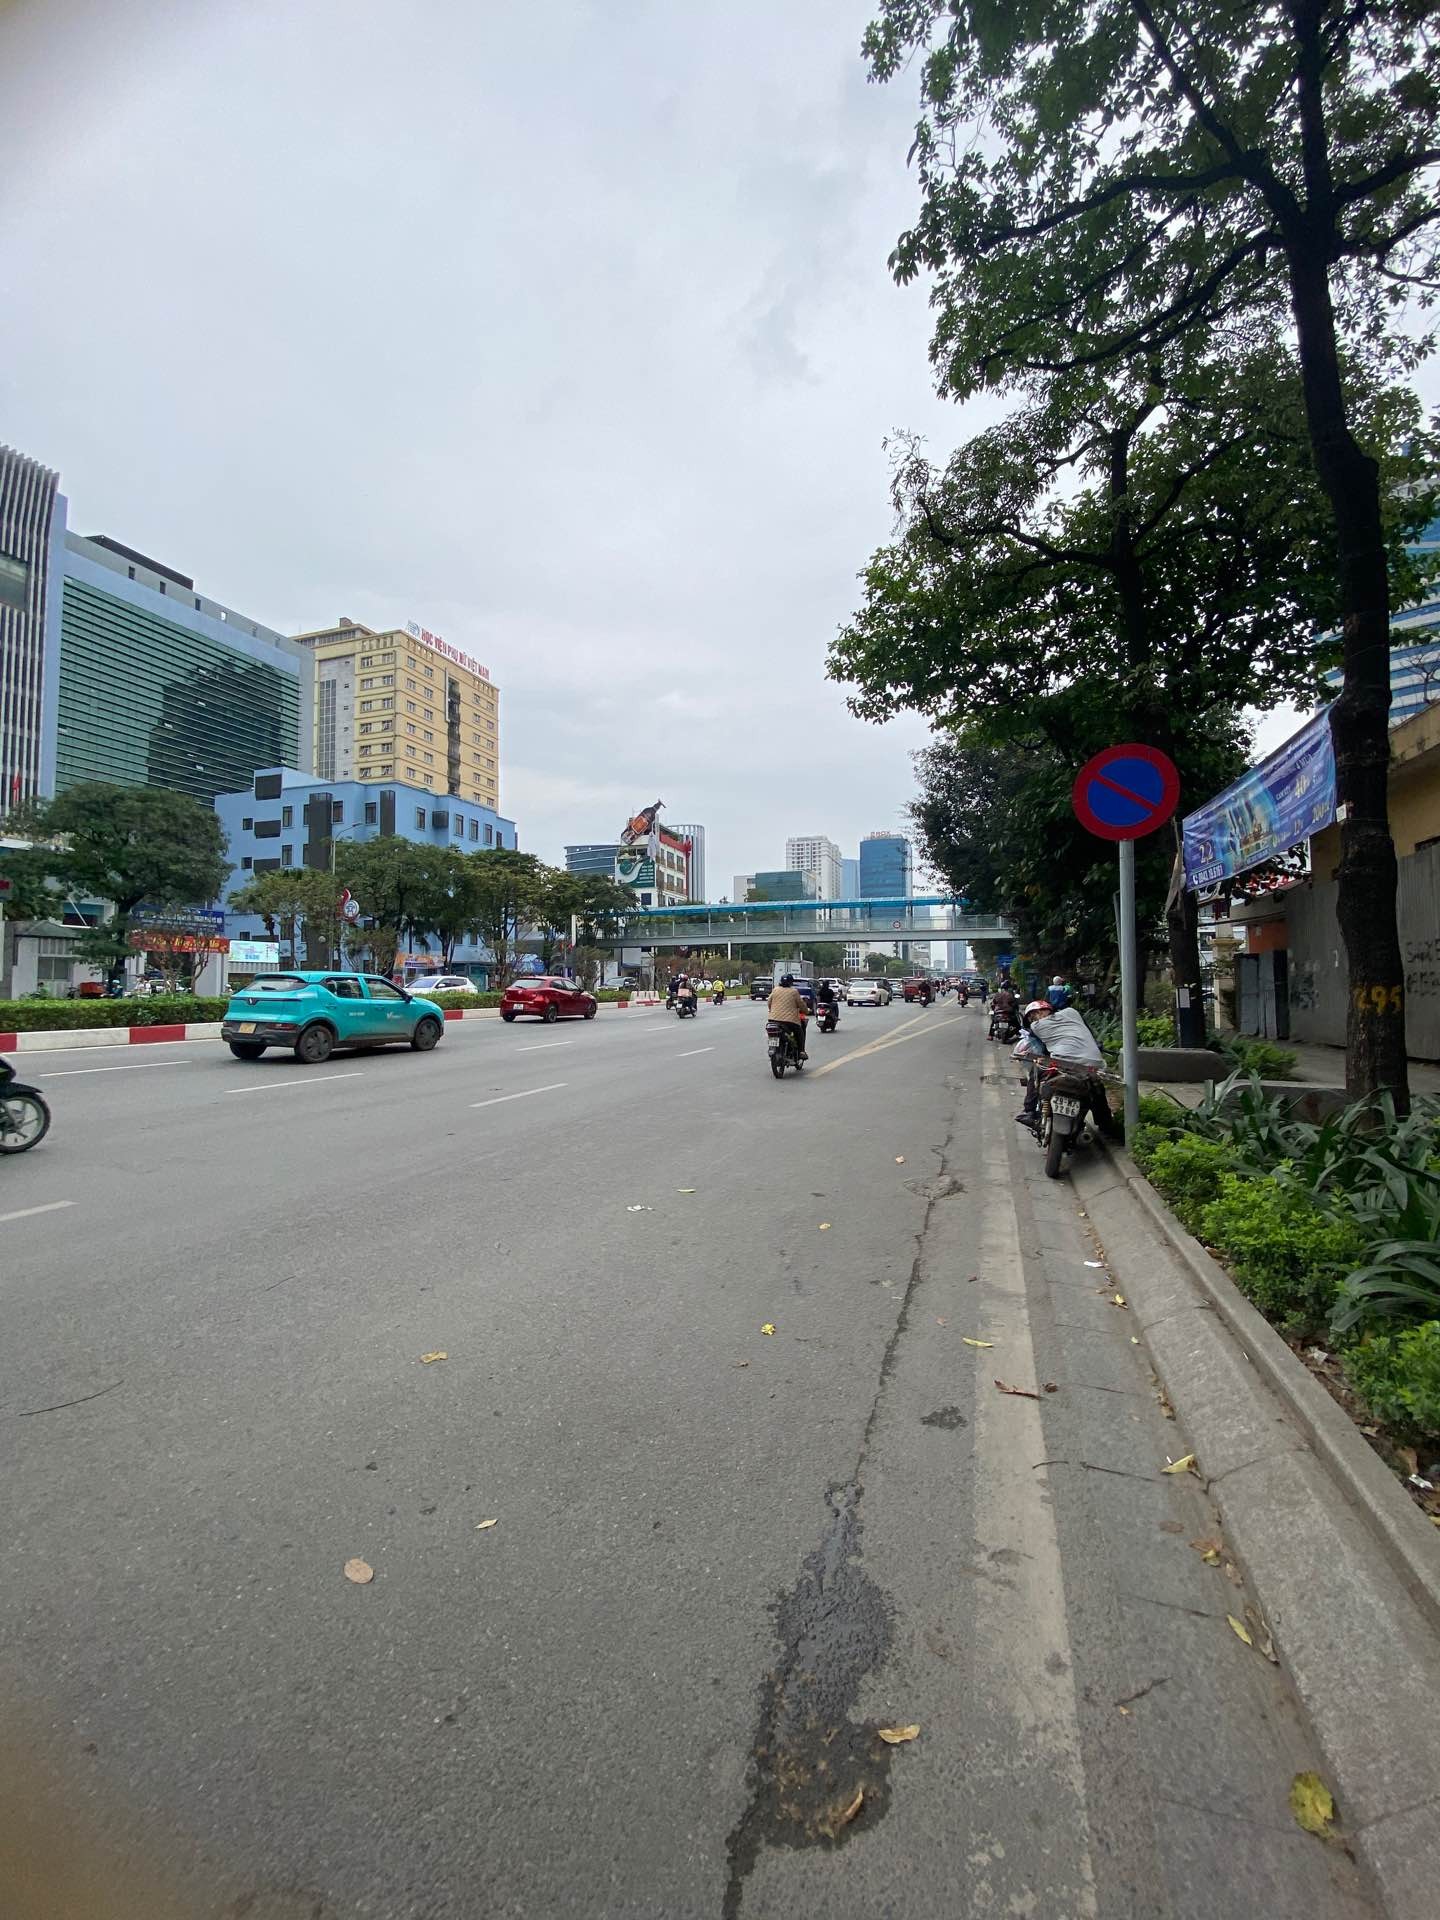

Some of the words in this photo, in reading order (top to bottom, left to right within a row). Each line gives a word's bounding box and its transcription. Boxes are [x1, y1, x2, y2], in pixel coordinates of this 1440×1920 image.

[421, 628, 434, 645] HỌC
[468, 657, 478, 673] VIỆT
[478, 664, 490, 680] NAM
